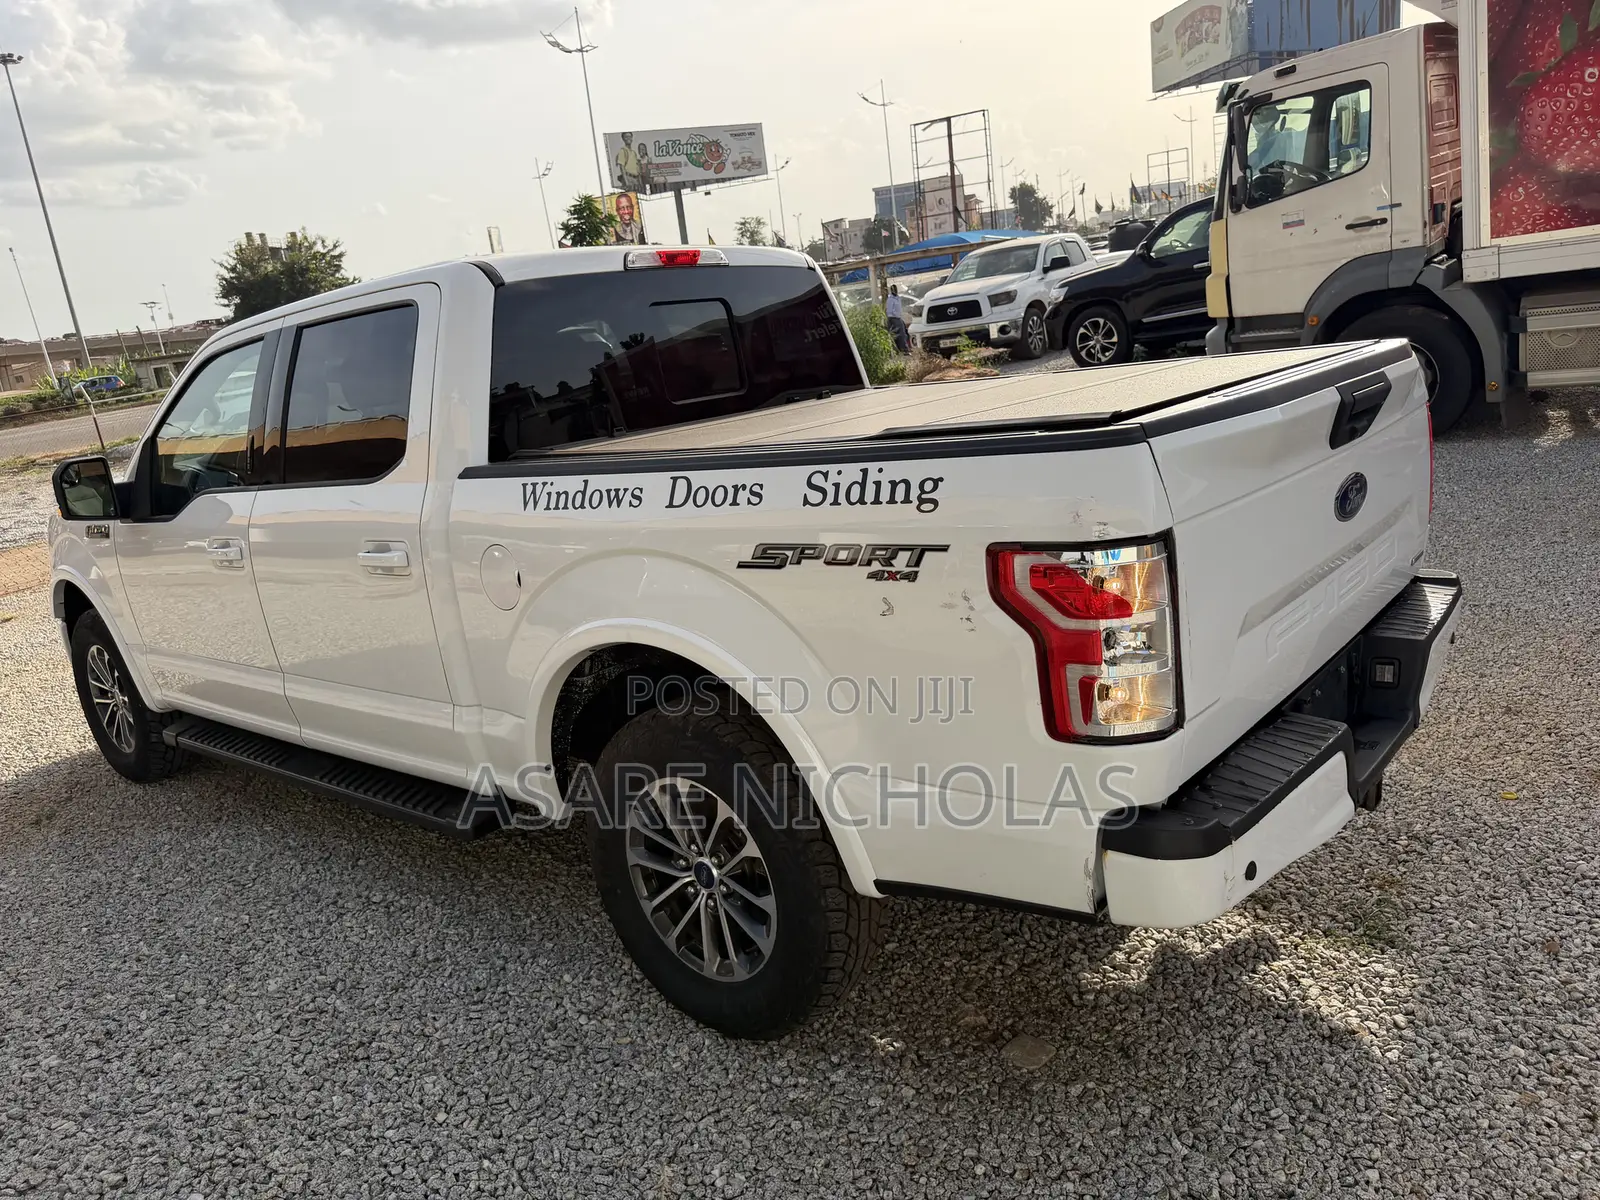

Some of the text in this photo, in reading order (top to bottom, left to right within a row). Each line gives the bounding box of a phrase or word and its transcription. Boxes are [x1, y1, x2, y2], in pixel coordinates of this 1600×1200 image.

[653, 139, 704, 157] laVonce
[521, 467, 944, 513] Windows Doors Siding
[736, 543, 951, 570] SPORT
